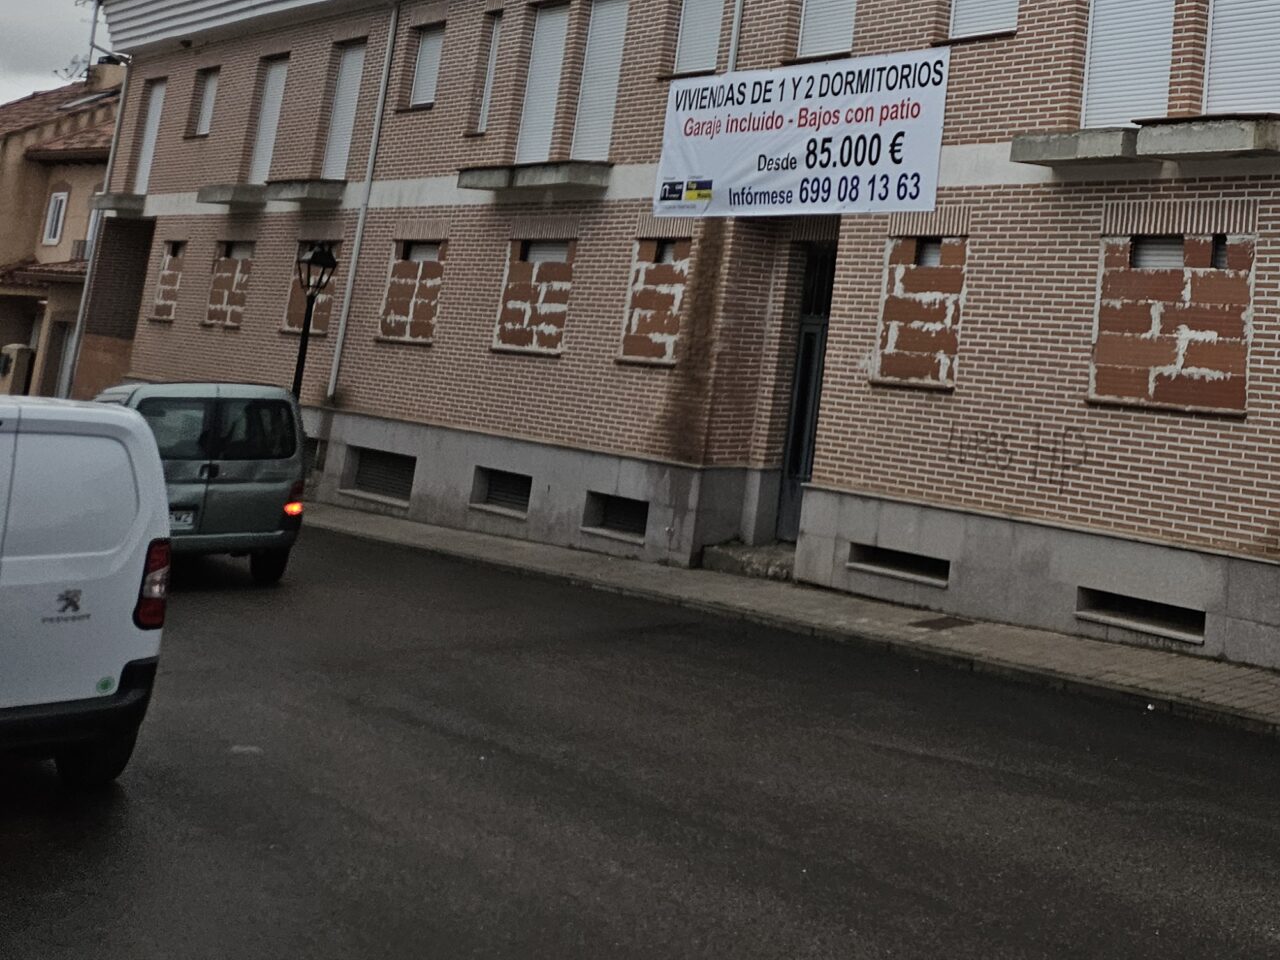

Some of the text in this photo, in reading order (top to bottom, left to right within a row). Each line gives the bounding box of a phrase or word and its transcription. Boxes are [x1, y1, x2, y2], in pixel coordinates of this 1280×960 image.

[674, 59, 944, 112] VIVIENDAS DE 1 Y 2 DORMITORIOS
[683, 117, 722, 139] Garaje
[725, 110, 783, 134] incluido
[797, 106, 840, 132] Bajos
[845, 105, 875, 124] con
[879, 97, 921, 126] patio
[757, 131, 905, 172] Desde 85.000 €
[728, 172, 921, 207] Infórmese 699 08 13 63
